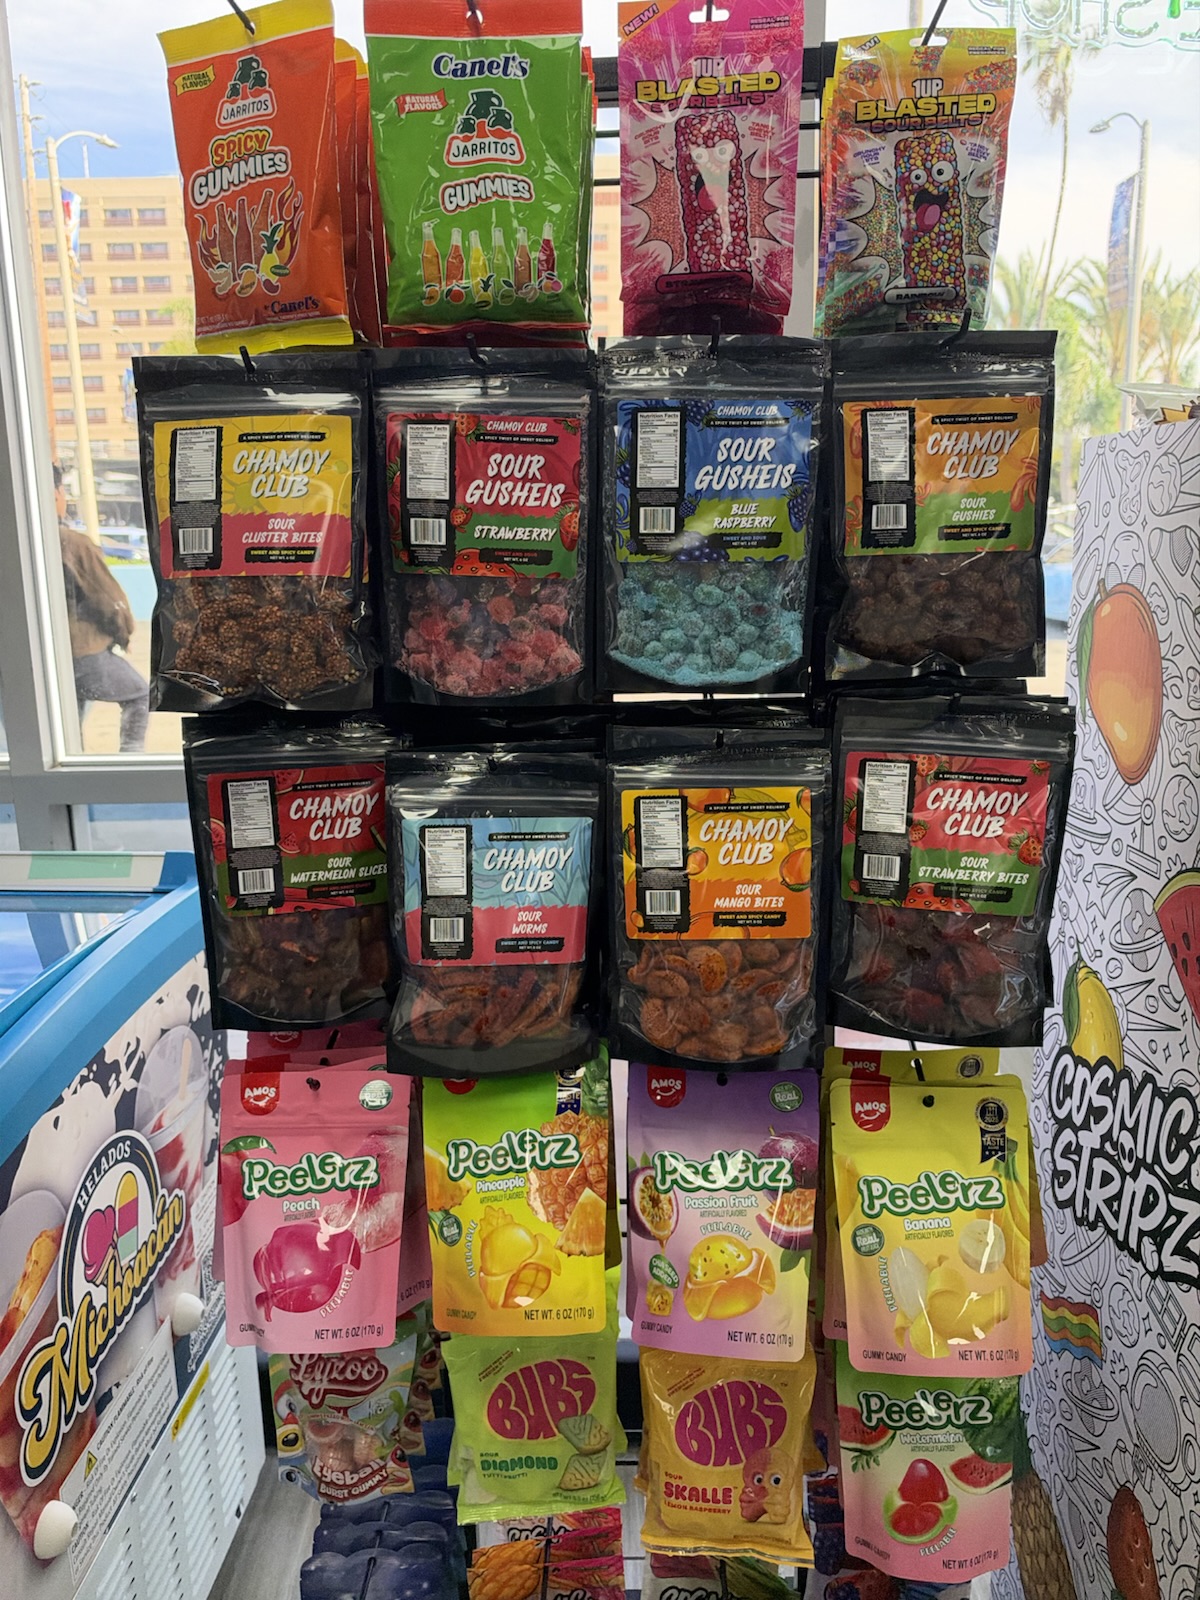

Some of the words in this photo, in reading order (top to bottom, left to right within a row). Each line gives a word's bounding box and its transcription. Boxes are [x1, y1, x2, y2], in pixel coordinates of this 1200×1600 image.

[623, 5, 660, 35] NEW!
[434, 55, 529, 78] Canel's
[182, 72, 210, 82] NATURAL
[636, 72, 781, 103] BLASTED
[912, 78, 943, 99] 1UP
[223, 99, 269, 120] JARRITOS
[405, 102, 443, 111] FLAVORS
[855, 94, 997, 123] BLASTED
[870, 117, 924, 134] SOUR
[924, 114, 984, 130] BELTS
[212, 130, 270, 167] SPICY
[452, 141, 516, 158] JARRITOS
[193, 153, 287, 204] GUMMIES
[444, 176, 531, 211] GUMMIES
[271, 296, 320, 314] Canel's
[717, 406, 754, 416] CHAMOY
[755, 405, 778, 416] CLUB
[487, 421, 523, 432] CHAMOY
[525, 422, 548, 433] CLUB
[716, 437, 776, 463] SOUR
[926, 428, 1021, 456] CHAMOY
[233, 448, 331, 475] CHAMOY
[487, 453, 546, 480] SOUR
[943, 455, 1000, 480] CLUB
[694, 464, 797, 491] GUSHEIS
[251, 475, 310, 499] CLUB
[465, 479, 566, 508] GUSHEIS
[730, 503, 759, 516] BLUE
[960, 497, 987, 509] SOUR
[268, 518, 296, 530] SOUR
[713, 516, 777, 529] RASPBERRY
[952, 509, 996, 522] GUSHIES
[242, 532, 288, 544] CLUSTER
[291, 531, 323, 544] BITES
[474, 525, 557, 542] STRAWBERRY
[289, 792, 380, 821] CHAMOY
[926, 787, 1029, 817] CHAMOY
[309, 817, 363, 841] CLUB
[699, 817, 795, 843] CHAMOY
[944, 814, 1006, 839] CLUB
[327, 857, 353, 869] SOUR
[483, 847, 574, 872] CHAMOY
[718, 842, 775, 866] CLUB
[960, 856, 990, 870] SOUR
[290, 868, 357, 884] WATERMELON
[358, 864, 387, 877] SLICES
[501, 871, 555, 893] CLUB
[918, 866, 996, 884] STRAWBERRY
[997, 872, 1030, 885] BITES
[735, 884, 763, 895] SOUR
[714, 897, 752, 909] MANGO
[754, 897, 785, 908] BITES
[517, 911, 543, 922] SOUR
[512, 923, 549, 935] WORMS
[244, 1086, 277, 1099] AMOS
[651, 1079, 683, 1090] AMOS
[774, 1091, 799, 1102] Real
[855, 1102, 887, 1114] AMOS
[1051, 1053, 1195, 1175] COSMIC
[982, 1137, 1005, 1147] TASTE
[75, 1138, 132, 1212] HELADOS
[476, 1175, 526, 1193] Pineapple
[283, 1197, 321, 1212] Peach
[685, 1196, 727, 1210] Passion
[730, 1195, 759, 1208] Fruit
[1053, 1128, 1200, 1279] STRIPZ
[726, 1209, 748, 1217] FLAVORED
[700, 1221, 752, 1241] PEELABLE
[903, 1217, 952, 1232] Banana
[856, 1236, 880, 1248] Real
[904, 1232, 932, 1241] ARTIFICIALLY
[932, 1230, 955, 1239] FLAVORED
[465, 1220, 479, 1279] PEELABLE
[652, 1267, 672, 1284] ADDED
[878, 1256, 898, 1313] PEELABLE
[319, 1268, 355, 1318] PEELABLE
[524, 1310, 540, 1320] NET
[541, 1309, 554, 1320] WT.
[556, 1310, 561, 1320] 6
[563, 1309, 573, 1320] OZ
[573, 1307, 587, 1320] (170
[588, 1307, 595, 1320] g)
[20, 1192, 184, 1480] Michoacán
[314, 1329, 329, 1340] NET
[331, 1328, 344, 1339] WT.
[345, 1329, 350, 1339] 6
[351, 1327, 361, 1337] OZ
[361, 1326, 376, 1338] (170
[376, 1325, 384, 1337] g)
[641, 1320, 656, 1332] GUMMY
[656, 1323, 673, 1334] CANDY
[727, 1330, 743, 1343] NET
[744, 1332, 759, 1344] WT.
[760, 1333, 765, 1344] 6
[766, 1333, 776, 1345] OZ
[777, 1334, 788, 1347] (170
[862, 1350, 885, 1360] GUMMY
[886, 1352, 907, 1362] CANDY
[958, 1350, 974, 1361] NET
[975, 1350, 989, 1361] WT.
[989, 1350, 995, 1361] 6
[996, 1350, 1004, 1361] OZ
[487, 1359, 597, 1440] BUBS
[675, 1380, 788, 1467] BUBS
[900, 1432, 964, 1445] Watermelon
[312, 1459, 385, 1485] Eyeball
[481, 1456, 559, 1472] DIAMOND
[319, 1483, 350, 1498] BURST
[351, 1469, 388, 1494] GUMMY
[664, 1472, 683, 1481] SOUR
[664, 1482, 733, 1505] SKALLE
[664, 1501, 689, 1511] LEMON
[689, 1505, 732, 1515] RASPBERRY
[919, 1527, 957, 1557] PEELABLE
